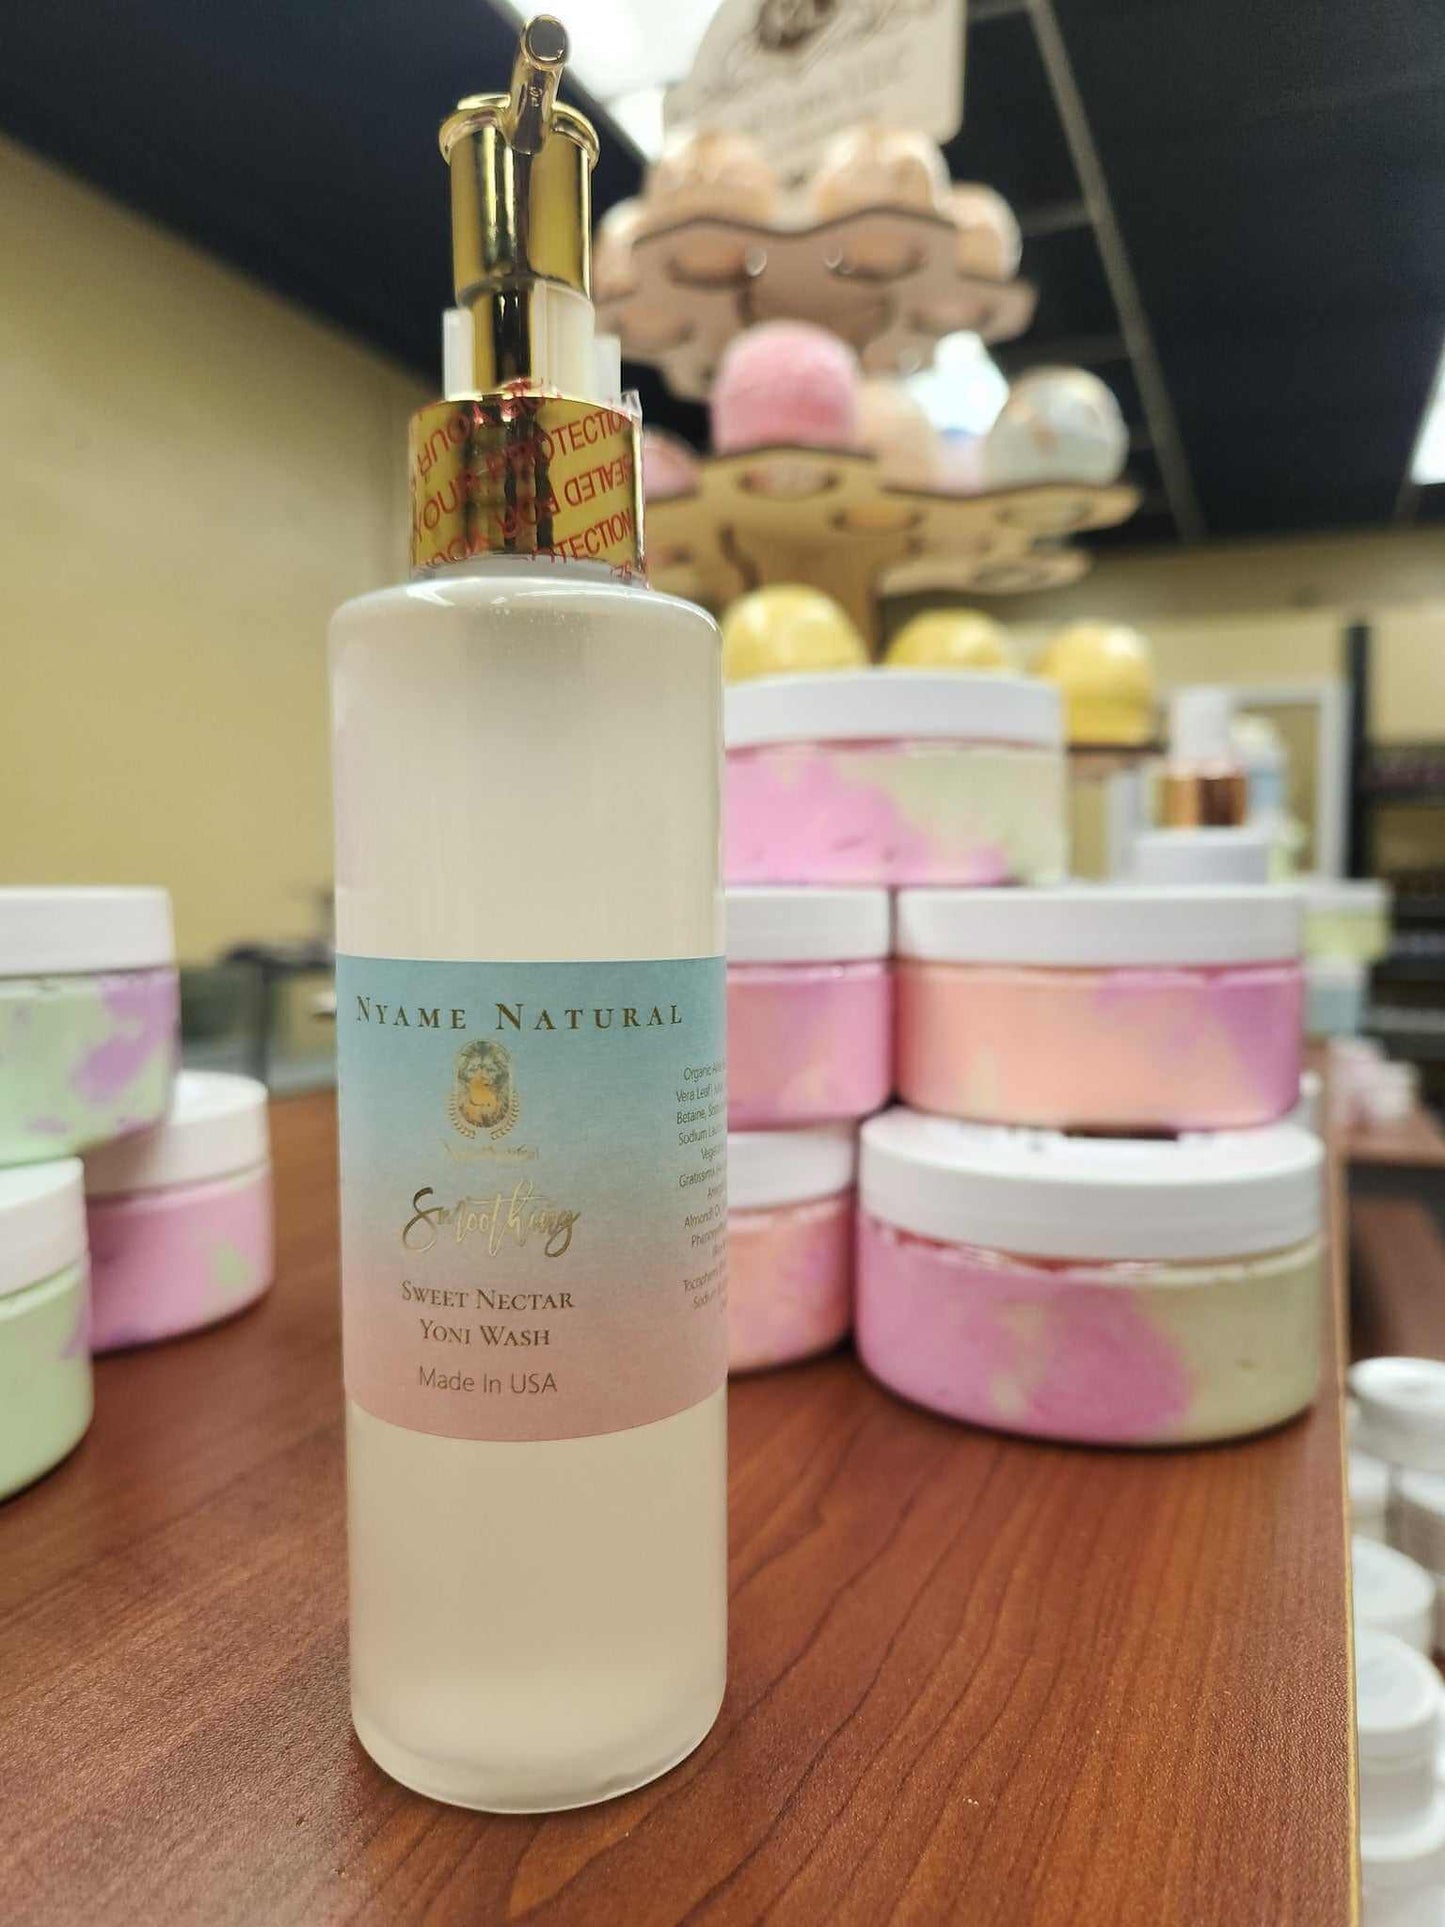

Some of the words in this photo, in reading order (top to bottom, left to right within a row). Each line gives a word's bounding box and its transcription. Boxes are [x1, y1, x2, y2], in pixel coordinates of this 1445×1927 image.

[356, 995, 466, 1030] NYAME
[494, 1002, 683, 1031] NATURAL
[400, 1279, 470, 1309] SWEET
[475, 1288, 576, 1311] NECTAR
[419, 1318, 472, 1346] YONI
[480, 1324, 551, 1347] WASH
[419, 1365, 475, 1393] Made
[483, 1373, 502, 1394] In
[511, 1372, 558, 1394] USA
